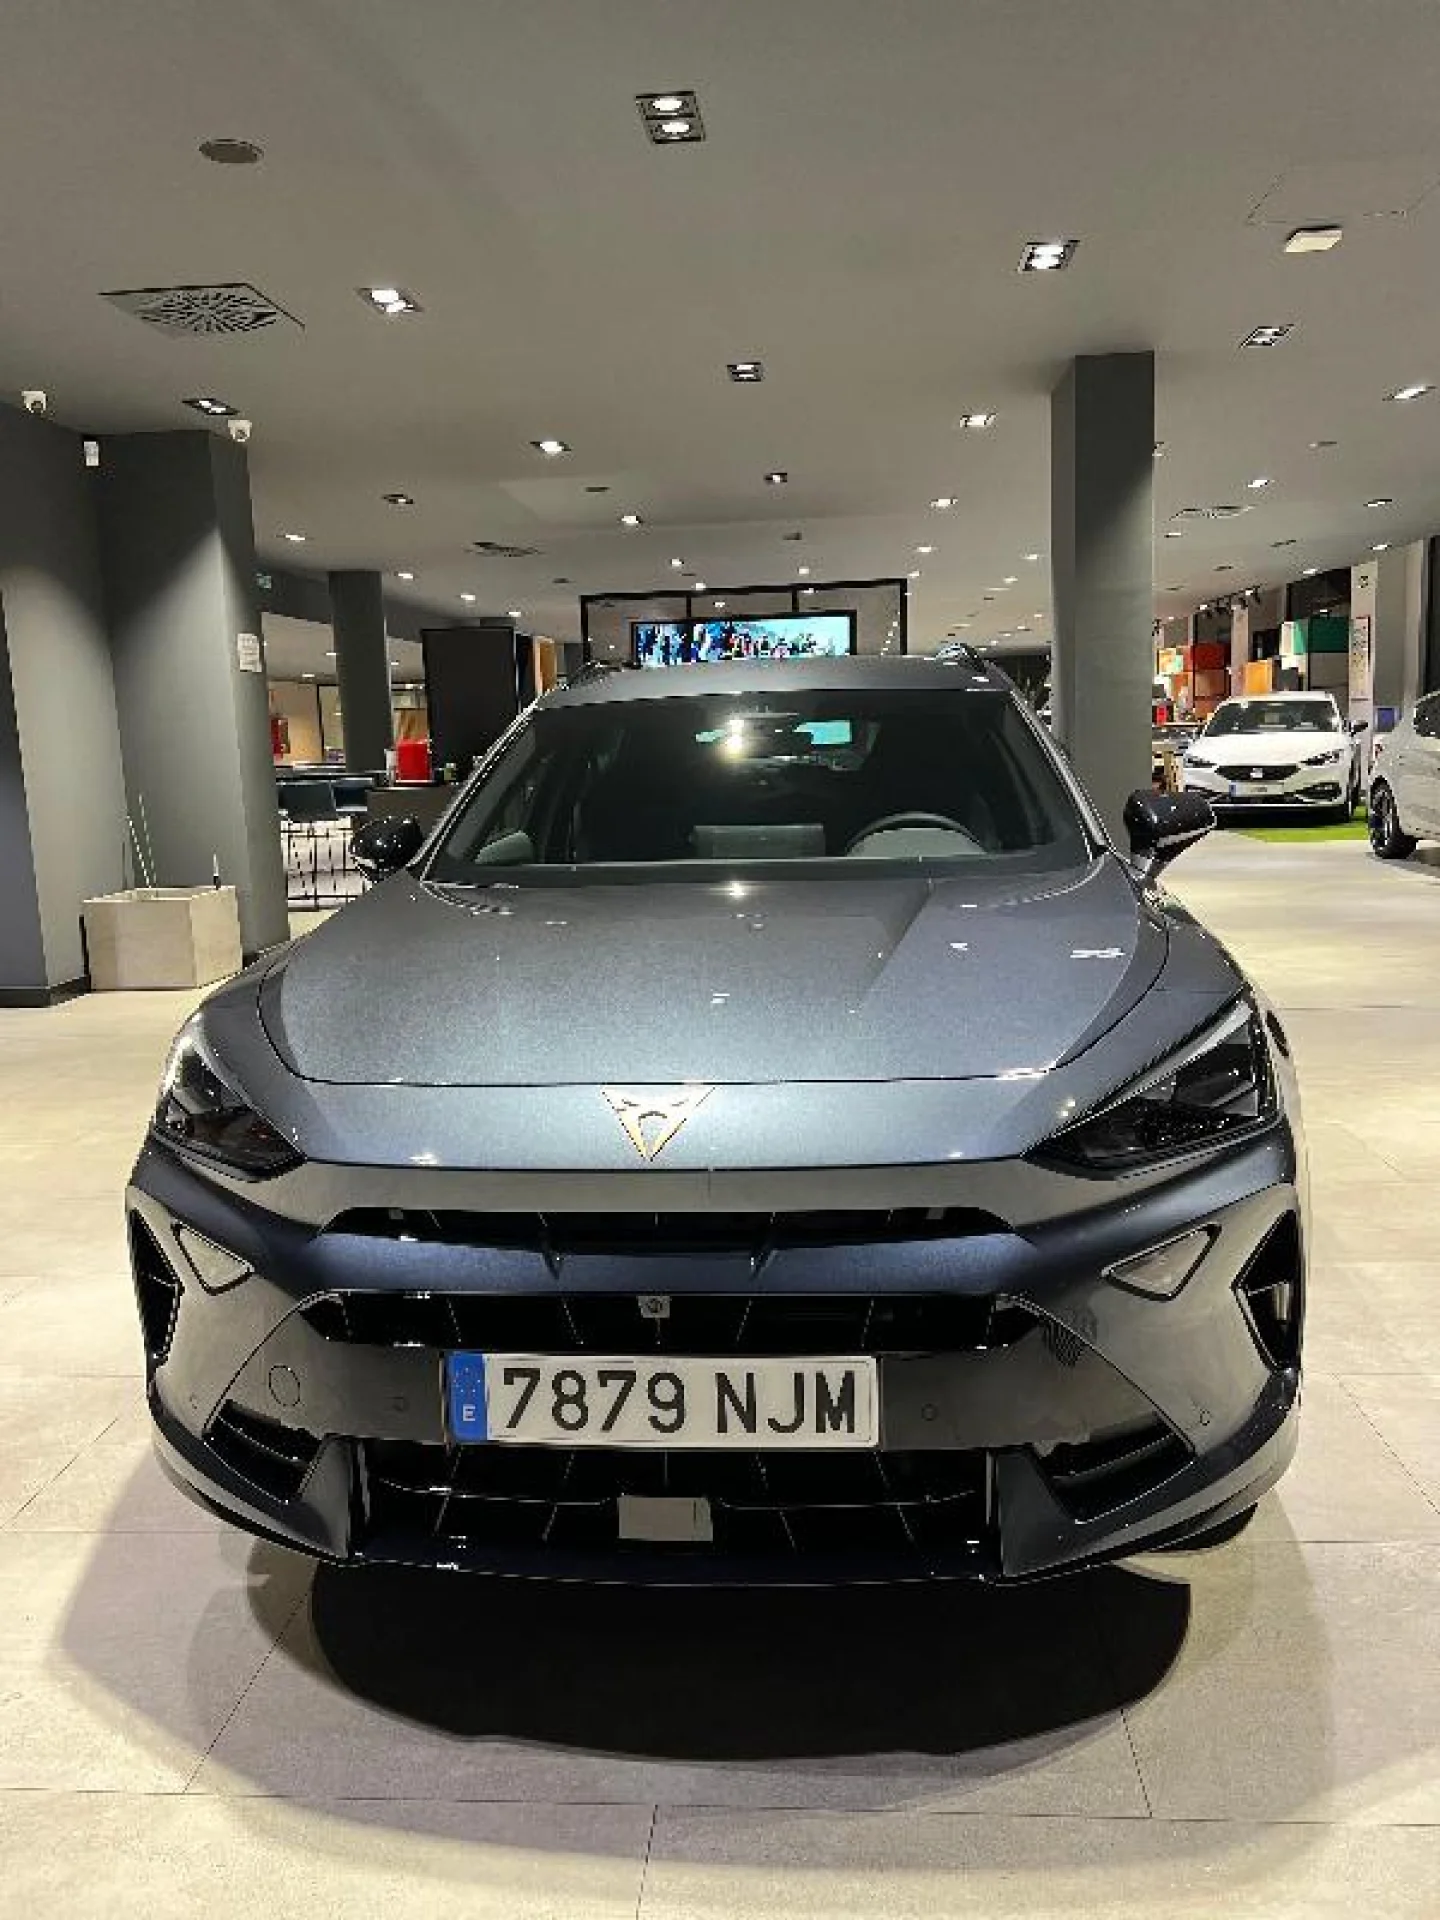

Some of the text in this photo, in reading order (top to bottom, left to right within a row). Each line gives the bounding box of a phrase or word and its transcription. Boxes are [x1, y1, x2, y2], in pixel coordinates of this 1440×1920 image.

[462, 1404, 476, 1422] E
[503, 1367, 856, 1434] 7879 NJM
